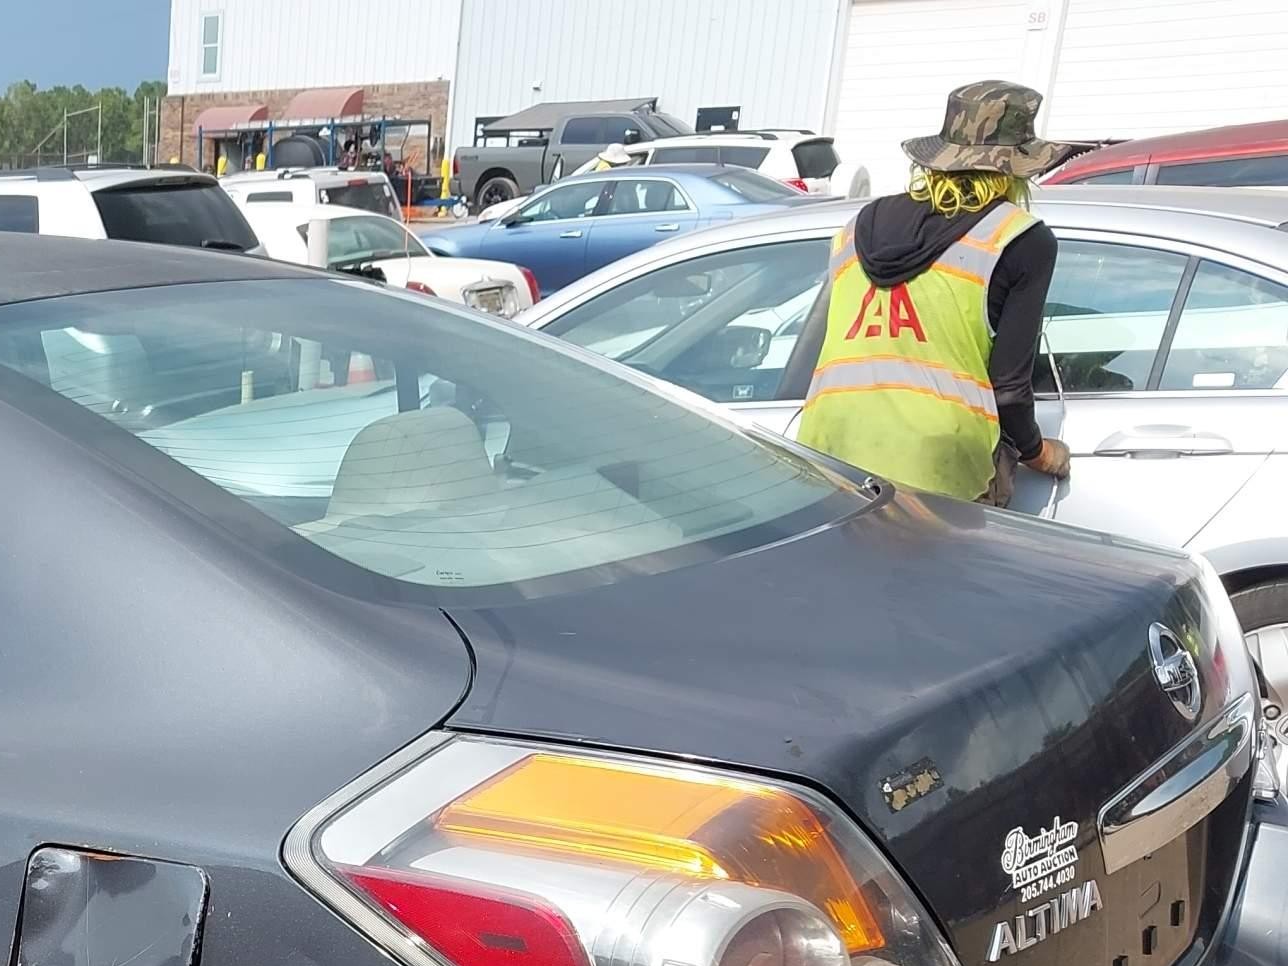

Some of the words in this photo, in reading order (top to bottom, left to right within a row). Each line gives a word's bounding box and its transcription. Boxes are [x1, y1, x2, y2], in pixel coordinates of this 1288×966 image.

[1002, 817, 1078, 873] Birmingham
[1015, 865, 1039, 885] AUTO
[1040, 848, 1076, 875] AUCTION
[1020, 865, 1076, 903] 205.744.4030
[985, 879, 1103, 962] ALTIMA
